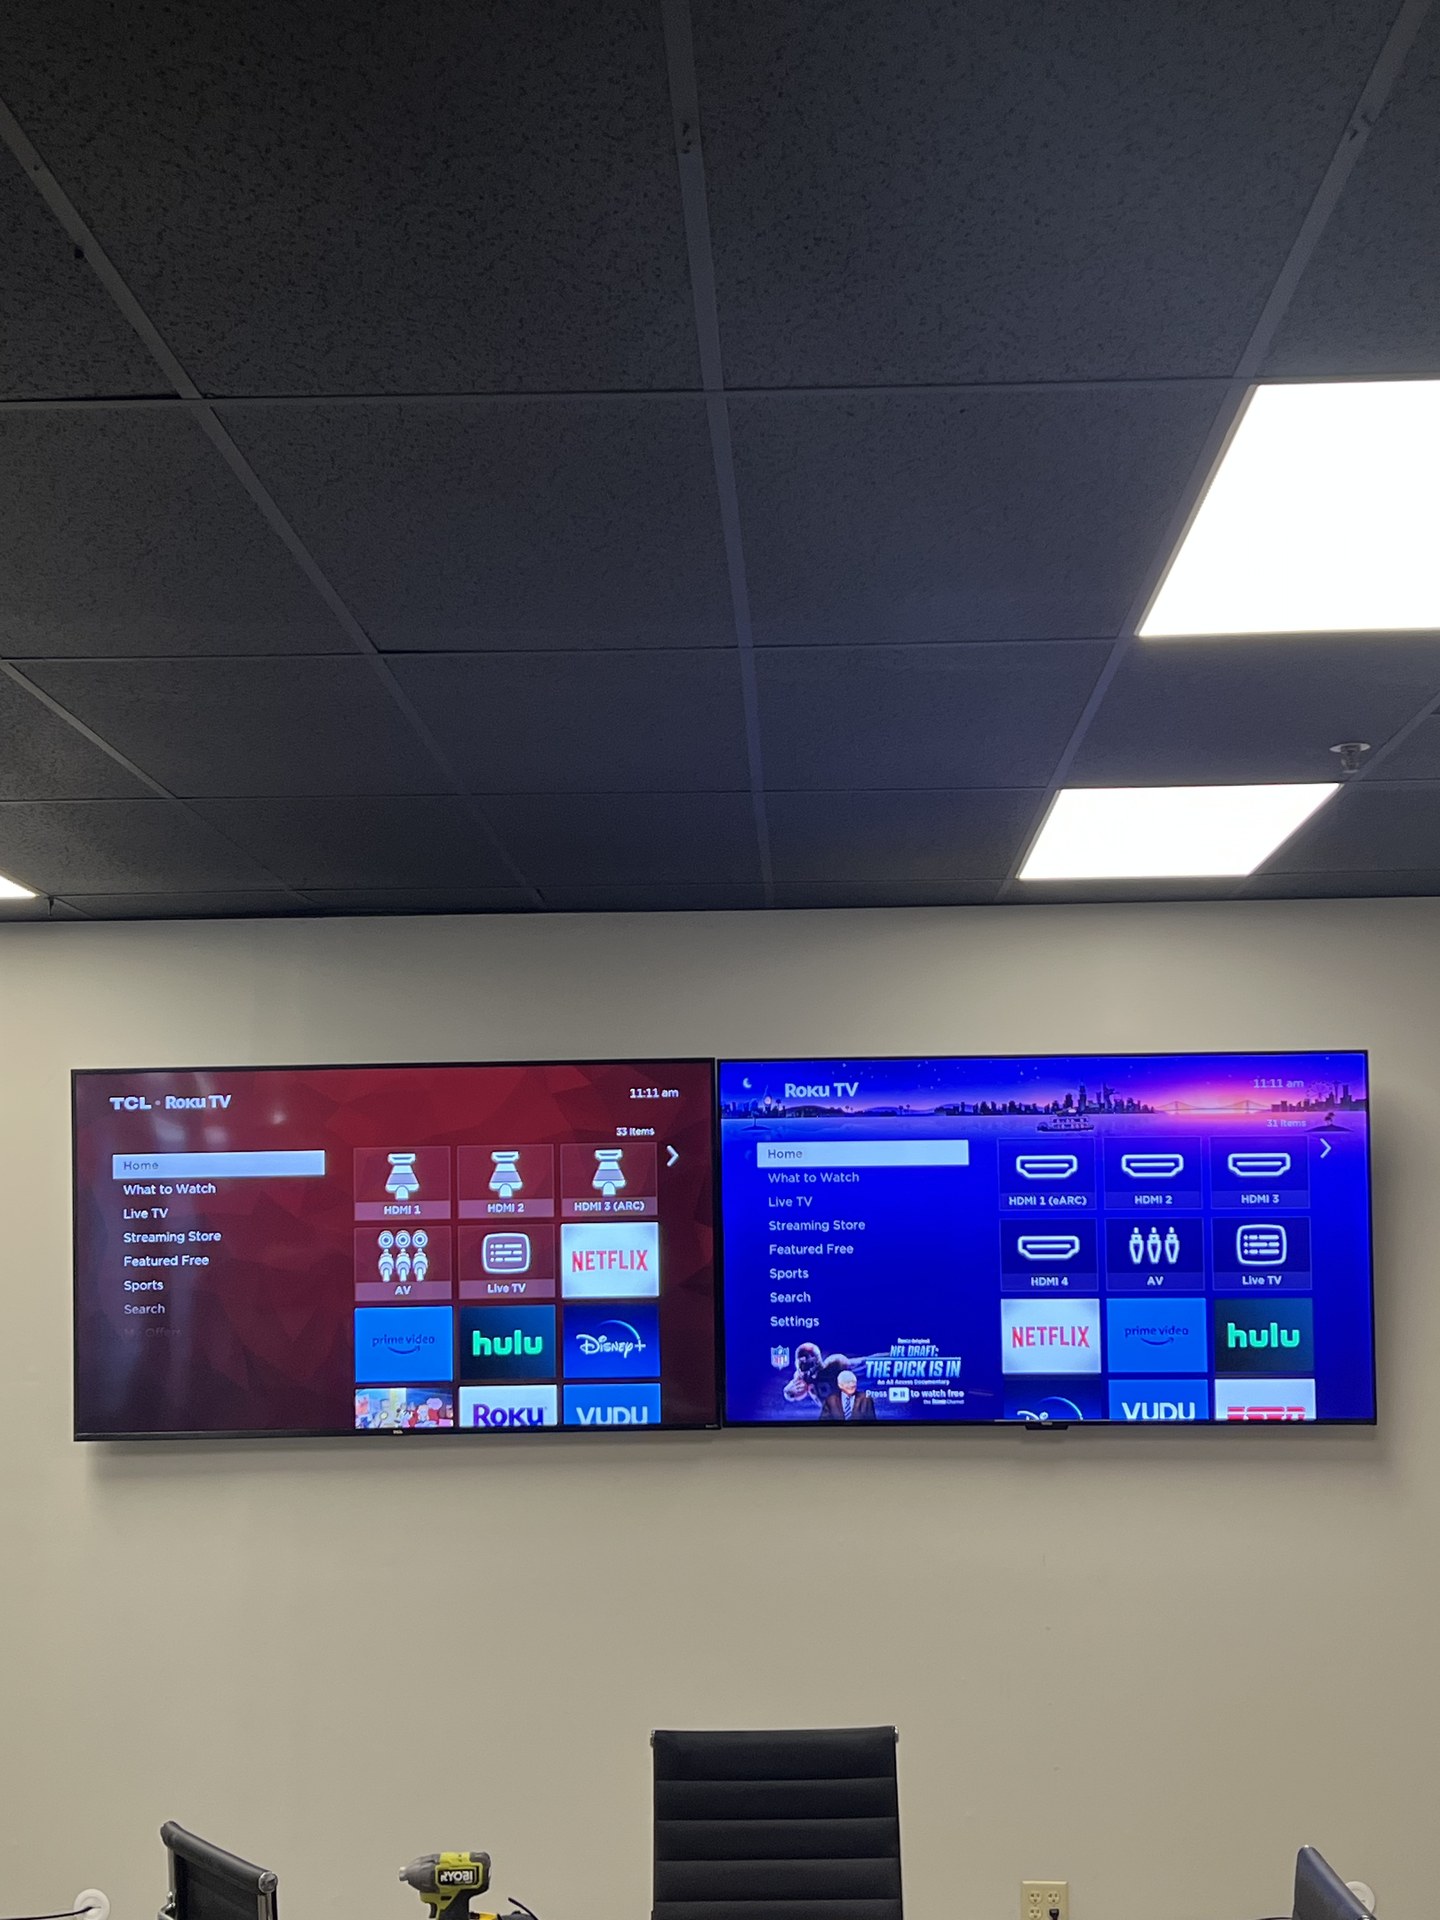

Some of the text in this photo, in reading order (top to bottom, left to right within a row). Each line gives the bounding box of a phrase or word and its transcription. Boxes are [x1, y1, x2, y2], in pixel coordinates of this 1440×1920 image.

[1253, 1079, 1304, 1088] 11:11 am
[629, 1088, 679, 1099] 11:11 am
[785, 1082, 859, 1098] Roku TV
[110, 1095, 232, 1110] TCL Roku TV
[1280, 1119, 1307, 1127] items
[616, 1127, 655, 1136] 33 items
[767, 1149, 803, 1159] Home
[123, 1160, 159, 1171] Home
[768, 1172, 860, 1183] What to Watch
[123, 1183, 216, 1195] What to Watch
[769, 1196, 813, 1207] Live TV
[1008, 1195, 1087, 1207] HDMI 1 (eARC)
[1134, 1195, 1173, 1205] HDMI 2
[1241, 1194, 1280, 1204] HDMI 3
[383, 1205, 421, 1215] HDMI 1
[487, 1203, 525, 1214] HDMI 2
[574, 1201, 645, 1213] HDMI 3 (ARC)
[123, 1208, 168, 1219] Live TV
[769, 1220, 866, 1233] Streaming Store
[123, 1231, 222, 1244] Streaming Store
[769, 1244, 854, 1255] Featured Free
[124, 1255, 210, 1267] Featured Free
[571, 1250, 649, 1273] NETFLIX
[769, 1268, 809, 1281] Sports
[1242, 1275, 1282, 1286] Live TV
[124, 1280, 164, 1293] Sports
[1030, 1276, 1069, 1286] HDMI 4
[1147, 1276, 1164, 1286] AV
[394, 1285, 412, 1295] AV
[487, 1283, 526, 1293] Live TV
[770, 1292, 811, 1303] Search
[124, 1303, 166, 1314] Search
[770, 1315, 820, 1329] Settings
[1012, 1326, 1090, 1349] NETFLIX
[1125, 1325, 1189, 1338] prime video
[1227, 1322, 1300, 1349] hulu
[372, 1334, 435, 1347] prime video
[472, 1329, 544, 1356] hulu
[889, 1345, 939, 1357] NFL DRAFT:
[866, 1359, 962, 1378] THE PICK IS IN
[865, 1389, 965, 1398] Press to watch free
[473, 1404, 544, 1426] Roku
[576, 1406, 648, 1425] VUDU
[1121, 1402, 1196, 1420] VUDU
[440, 1870, 473, 1882] RYOBI
